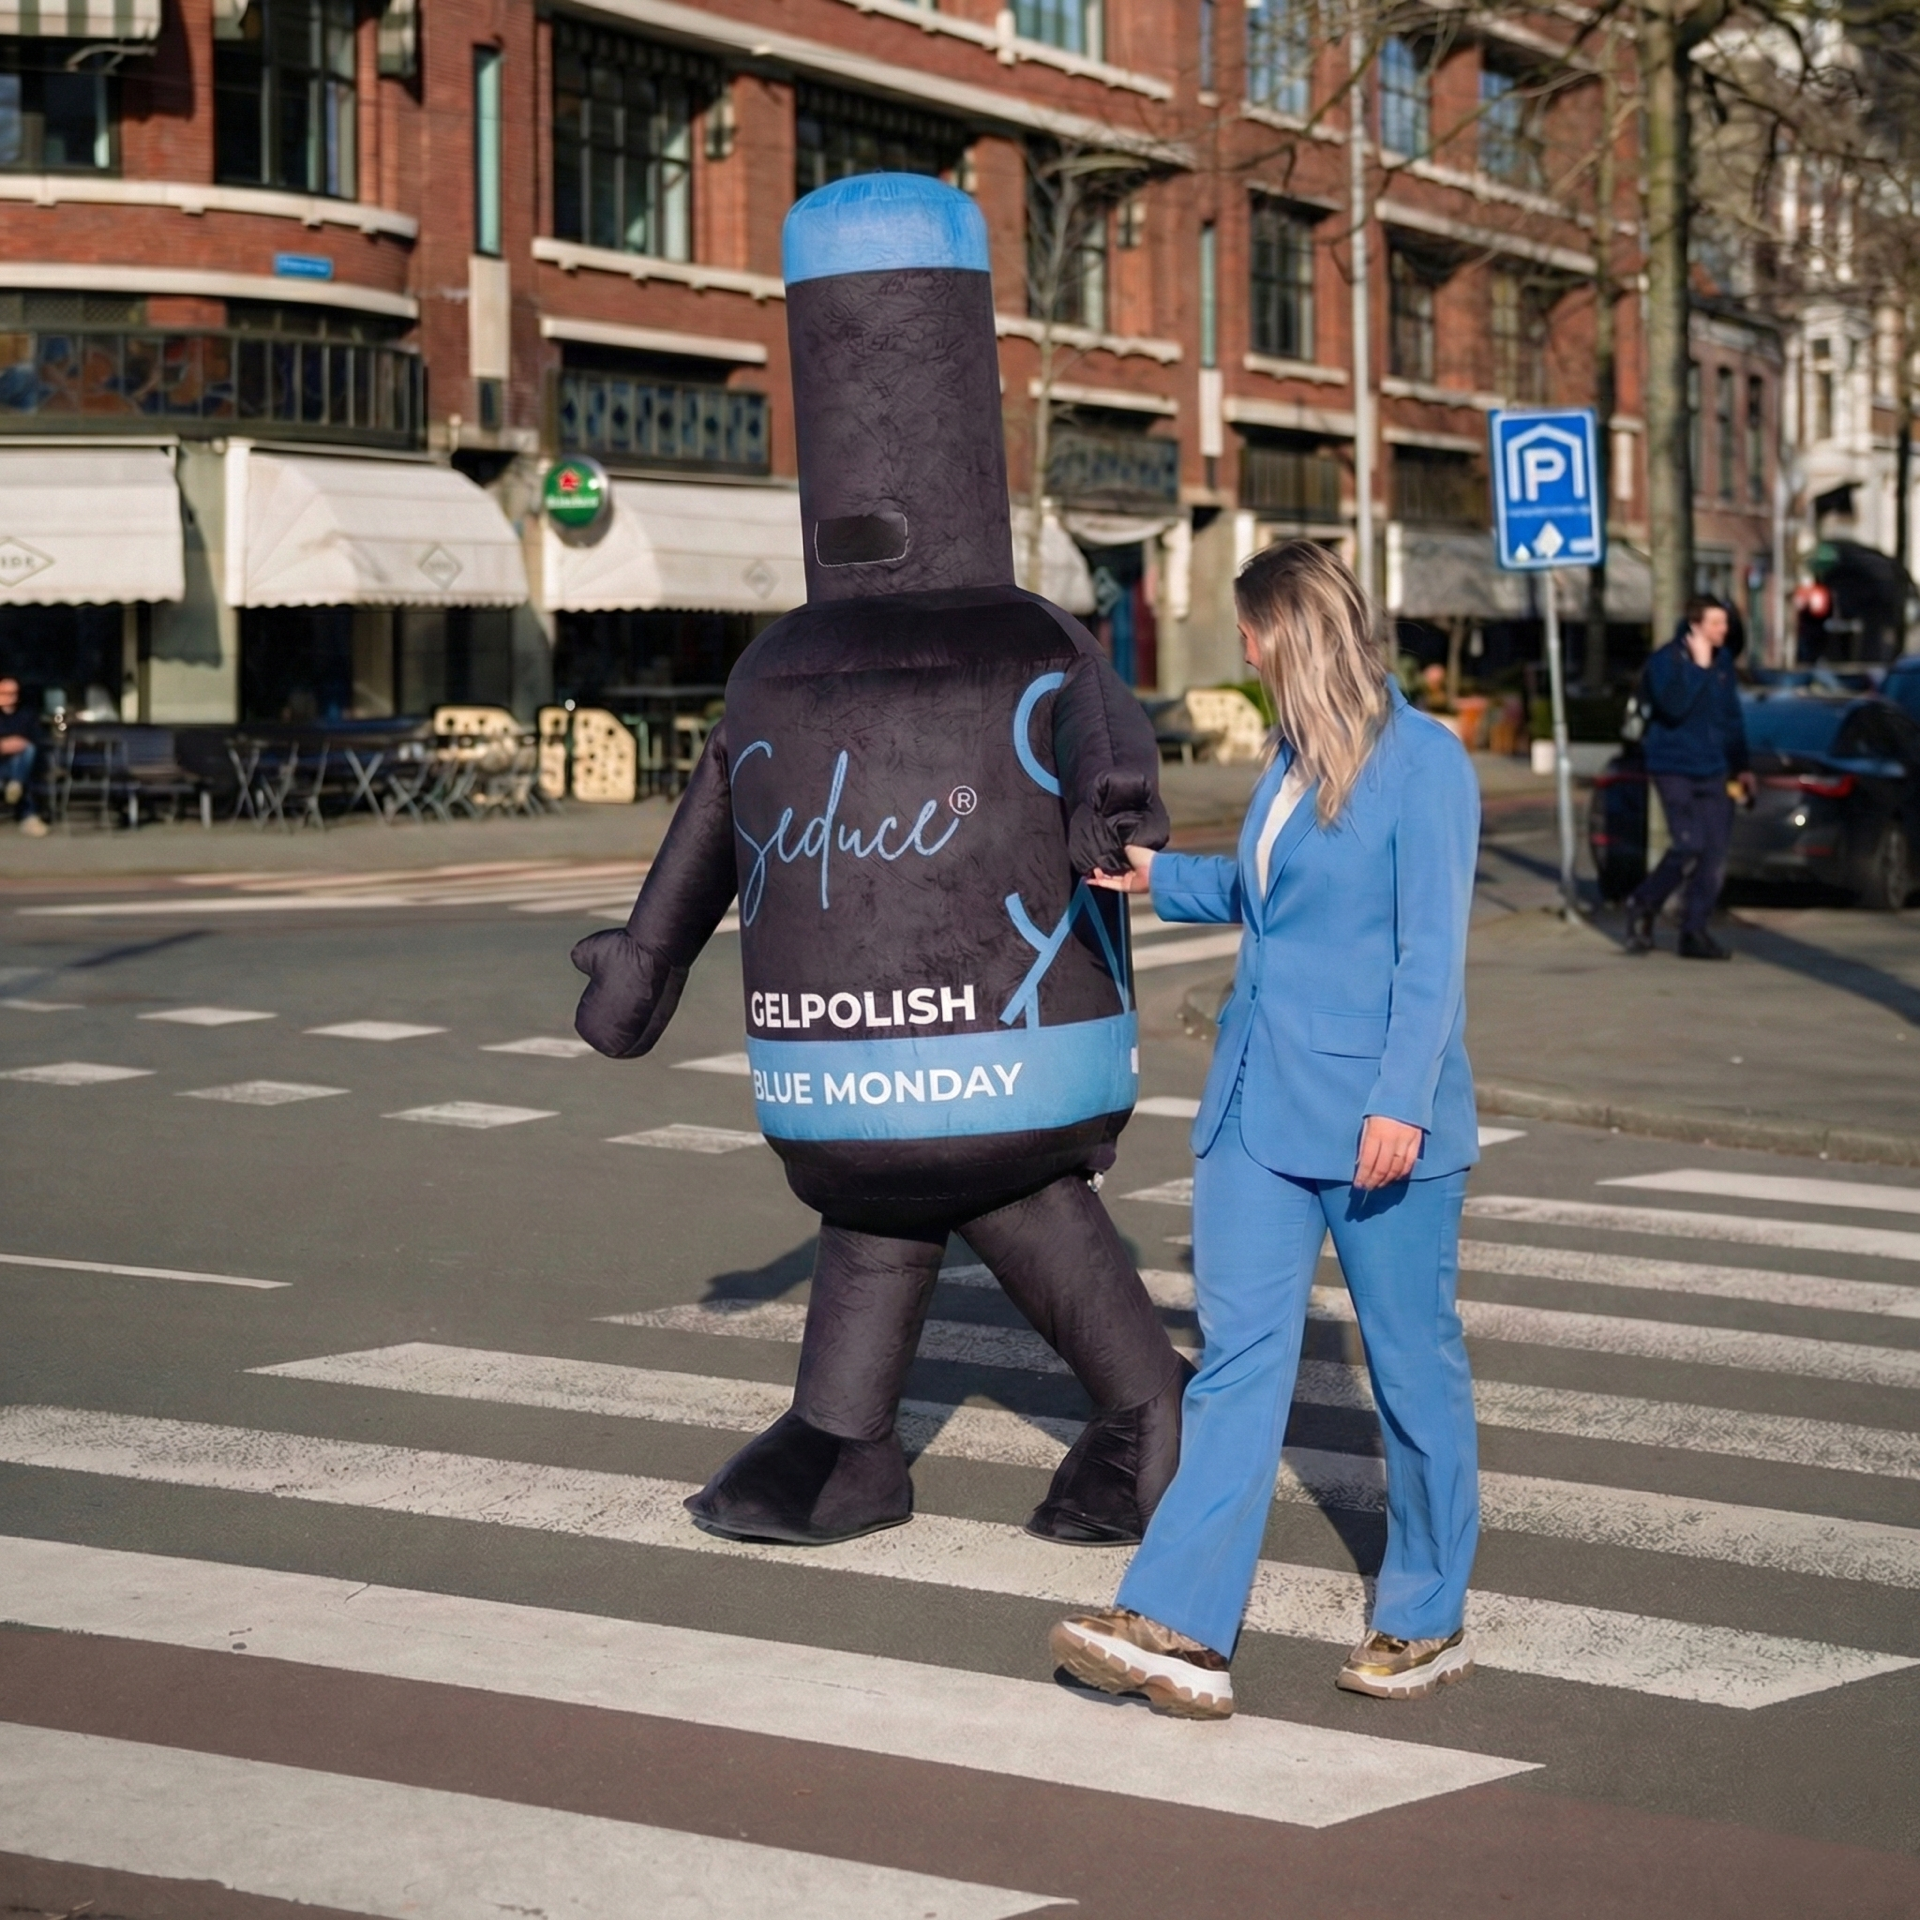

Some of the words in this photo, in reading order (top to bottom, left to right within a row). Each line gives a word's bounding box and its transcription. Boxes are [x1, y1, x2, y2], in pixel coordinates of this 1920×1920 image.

[1523, 448, 1567, 502] P
[751, 984, 976, 1029] GELPOLISH
[753, 1068, 813, 1105] BLUE
[824, 1062, 1023, 1105] MONDAY
